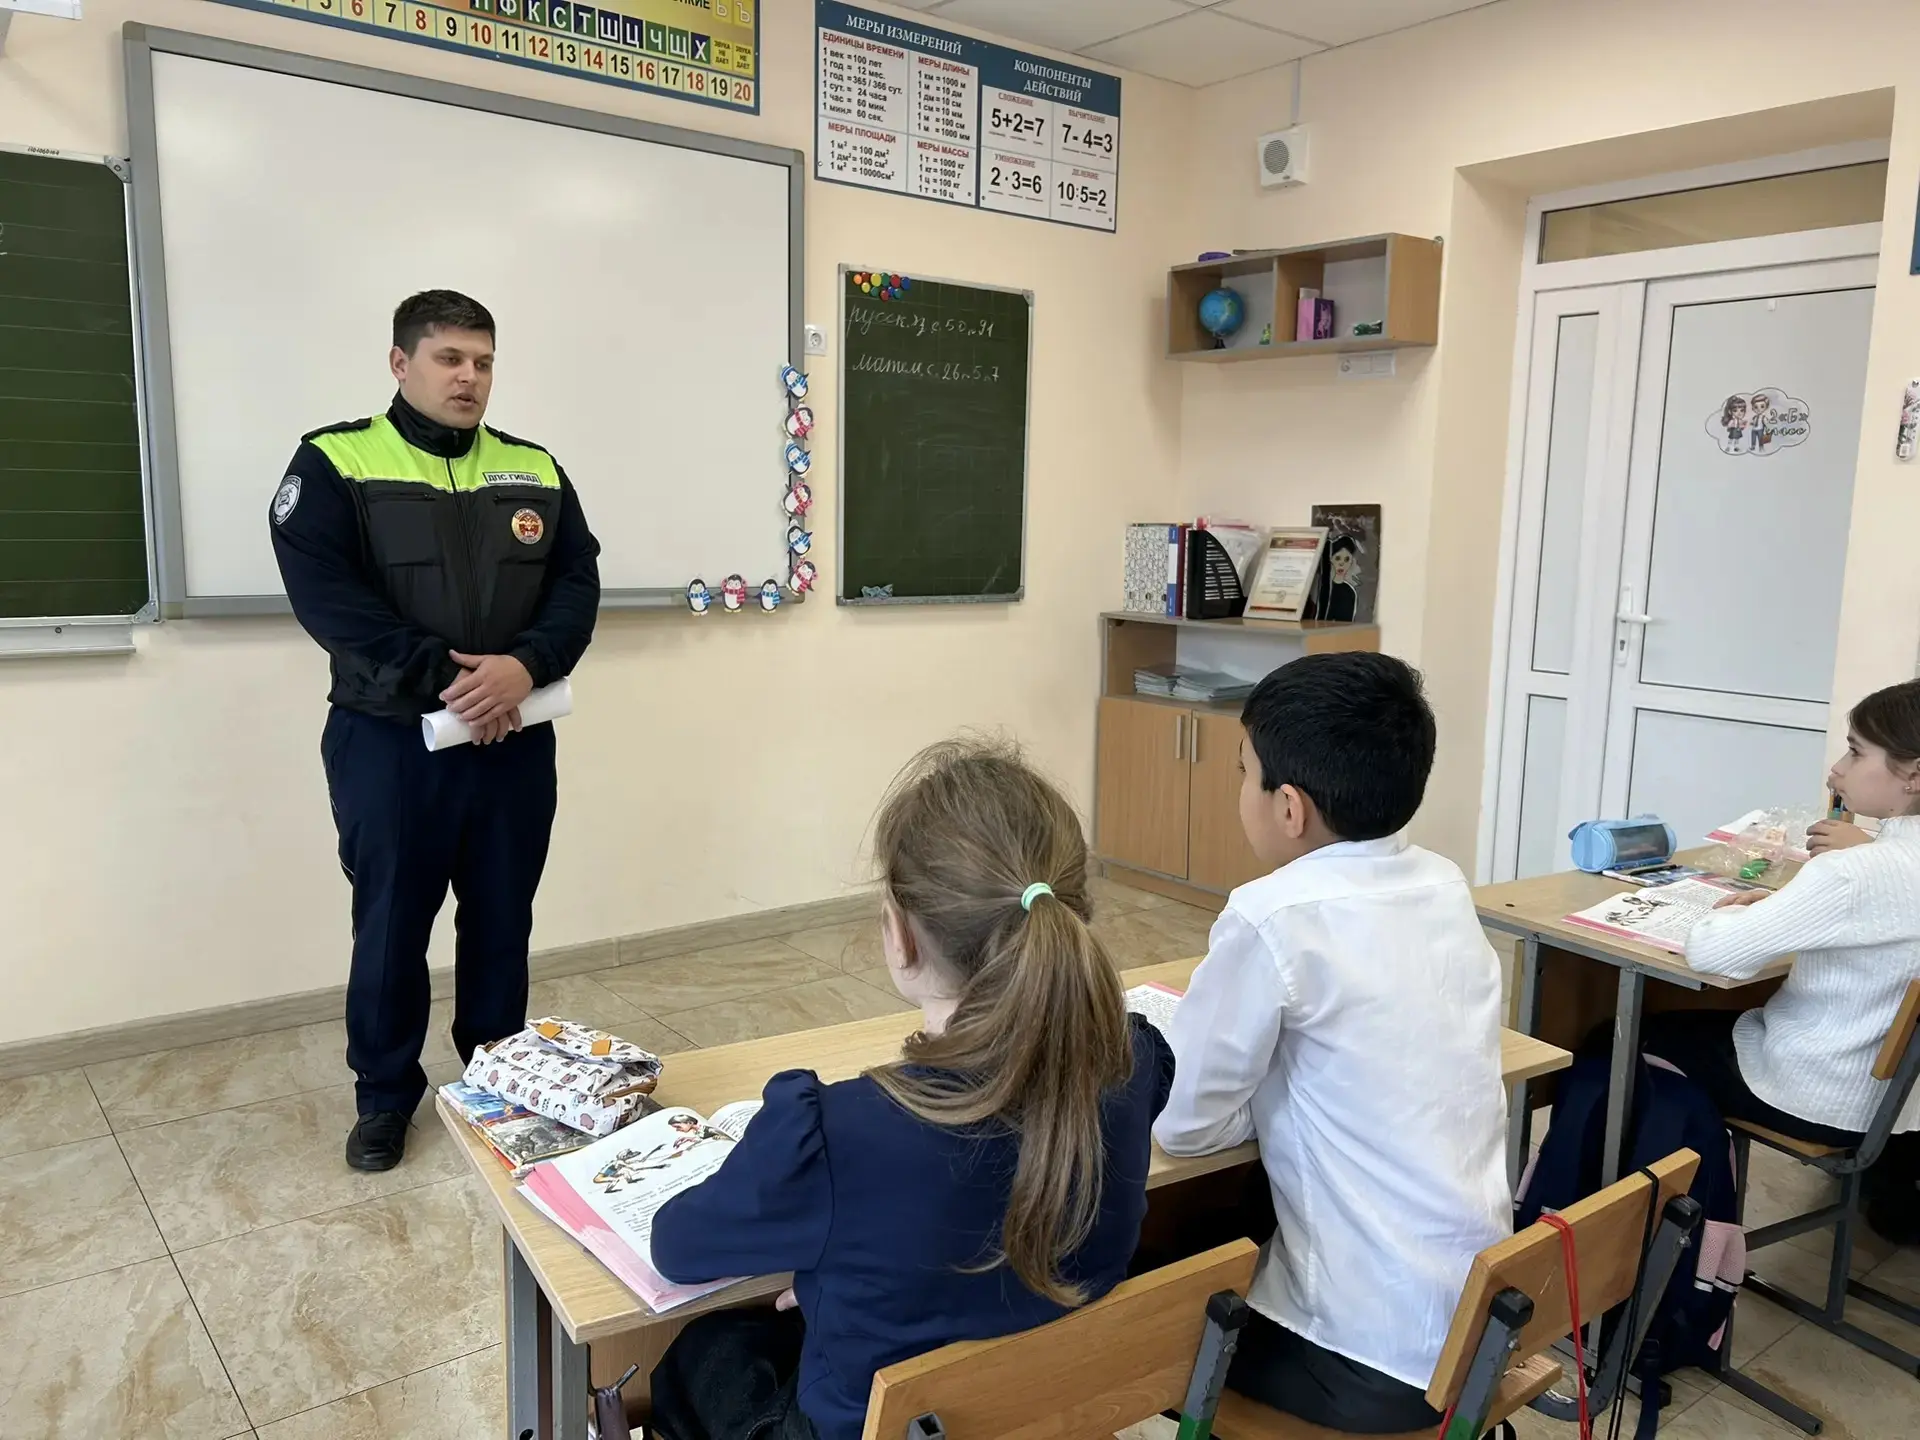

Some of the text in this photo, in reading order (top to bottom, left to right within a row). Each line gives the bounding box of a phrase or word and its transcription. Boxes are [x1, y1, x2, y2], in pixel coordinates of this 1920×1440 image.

[528, 0, 541, 23] К
[553, 6, 567, 29] С
[578, 11, 591, 33] Т
[736, 1, 751, 23] Ъ
[600, 16, 618, 41] Ш
[626, 23, 639, 49] Ц
[846, 15, 962, 55] МЕРЫ ИЗМЕРЕНИЙ
[352, 0, 364, 17] 6
[385, 2, 397, 23] 7
[415, 9, 426, 30] 8
[446, 16, 457, 37] 9
[471, 22, 492, 45] 10
[502, 29, 519, 51] 11
[528, 35, 549, 58] 12
[556, 42, 576, 64] 13
[584, 48, 603, 69] 14
[610, 54, 629, 75] 15
[636, 60, 655, 81] 16
[662, 66, 680, 86] 17
[687, 71, 704, 91] 18
[710, 76, 728, 97] 19
[734, 82, 751, 102] 20
[650, 29, 662, 51] Ч
[670, 33, 688, 59] Щ
[695, 40, 707, 62] Х
[823, 32, 904, 60] ЕДИНИЦЫ ВРЕМЕНИ
[823, 47, 883, 68] 1 век 100 лет
[918, 56, 970, 76] МЕРЫ ДЛИНЫ
[823, 58, 886, 80] 1 год 12 мес.
[918, 70, 922, 78] 1
[924, 73, 934, 81] км
[942, 76, 959, 87] 1000
[1013, 59, 1092, 89] КОМПОНЕНТЫ
[823, 69, 827, 77] 1
[829, 71, 844, 82] год
[853, 76, 867, 86] 365
[873, 80, 887, 91] 366
[888, 85, 903, 95] сут.
[823, 80, 887, 102] 1 сут. 24 часа
[918, 80, 922, 89] 1
[942, 86, 951, 95] 10
[951, 90, 962, 98] дм
[1023, 79, 1082, 103] ДЕЙСТВИЙ
[823, 91, 886, 112] 1 час 60 мин.
[918, 91, 962, 108] 1 дм 10 см
[918, 102, 963, 119] 1 см 10 мм
[823, 102, 827, 110] 1
[857, 109, 867, 119] 60
[868, 113, 883, 122] сек.
[917, 112, 922, 120] 1
[941, 117, 954, 127] 100
[955, 122, 966, 130] см
[991, 108, 1045, 137] 5+2=7
[828, 122, 896, 144] МЕРЫ ПЛОЩАДИ
[917, 123, 921, 131] 1
[941, 128, 958, 138] 1000
[959, 133, 970, 141] мм
[917, 141, 969, 158] МЕРЫ МАССЫ
[1057, 181, 1107, 207] 10:5=2
[1768, 408, 1778, 424] 2
[488, 474, 539, 483] ДПС ГИБДД
